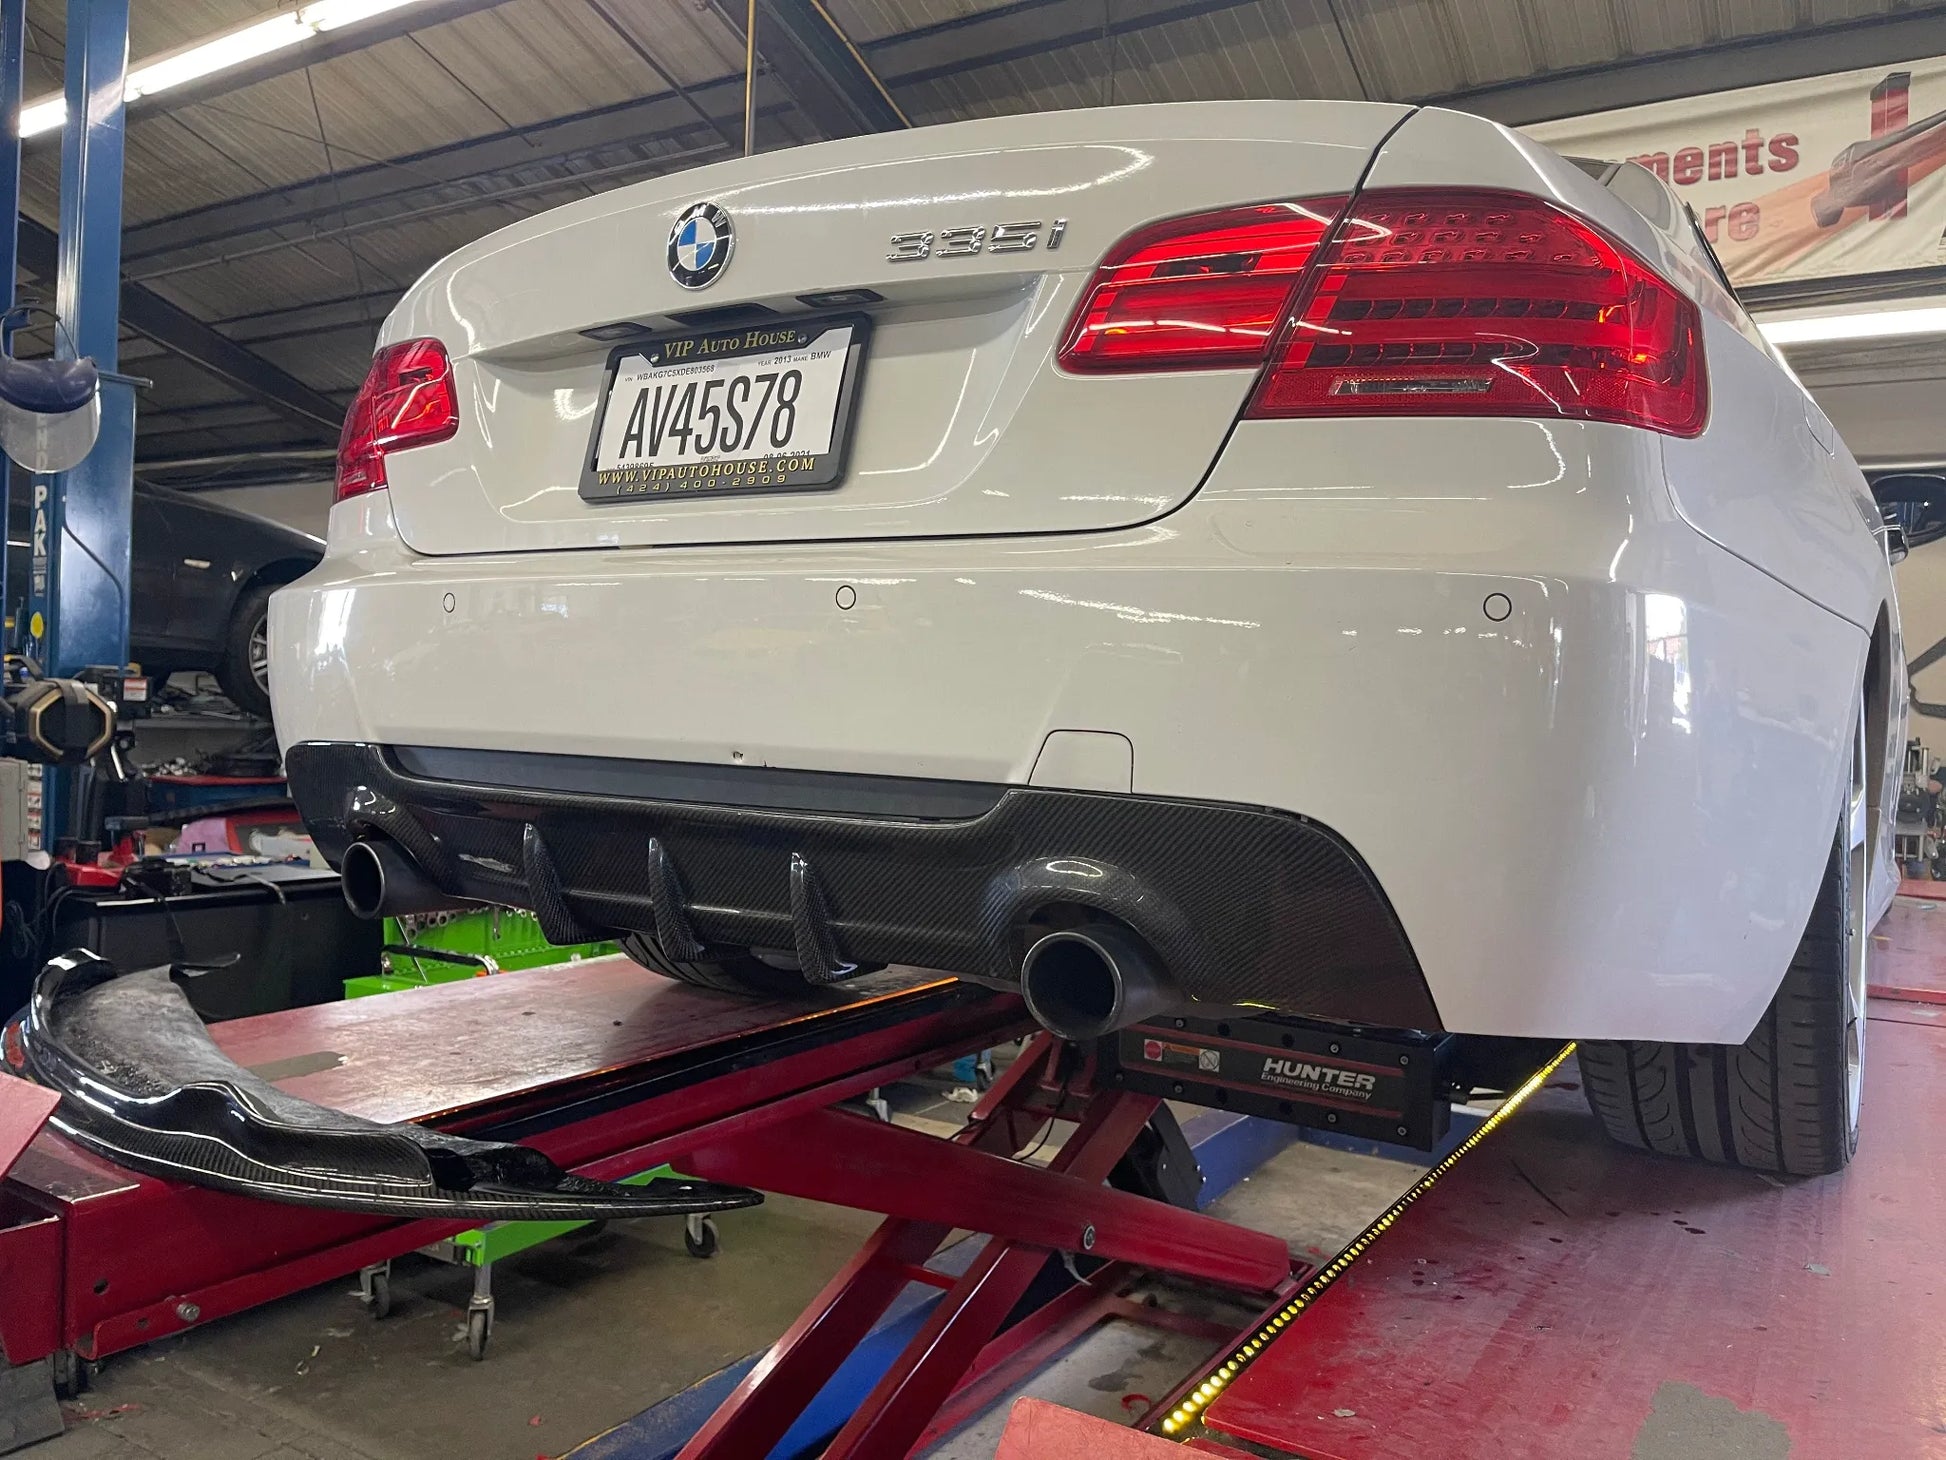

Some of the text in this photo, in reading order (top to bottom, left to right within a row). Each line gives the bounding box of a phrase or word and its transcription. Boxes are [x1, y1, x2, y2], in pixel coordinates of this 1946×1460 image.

[885, 217, 1069, 264] 335i
[664, 340, 695, 359] VIP
[774, 355, 792, 365] 2013
[810, 350, 832, 361] BMW
[618, 369, 803, 459] AV45S78
[599, 457, 816, 486] WWW.VIPAUTOHOUSE.COM
[616, 482, 671, 495] (424)
[1260, 1072, 1373, 1101] Engineering Company
[1263, 1058, 1376, 1090] HUNTER
